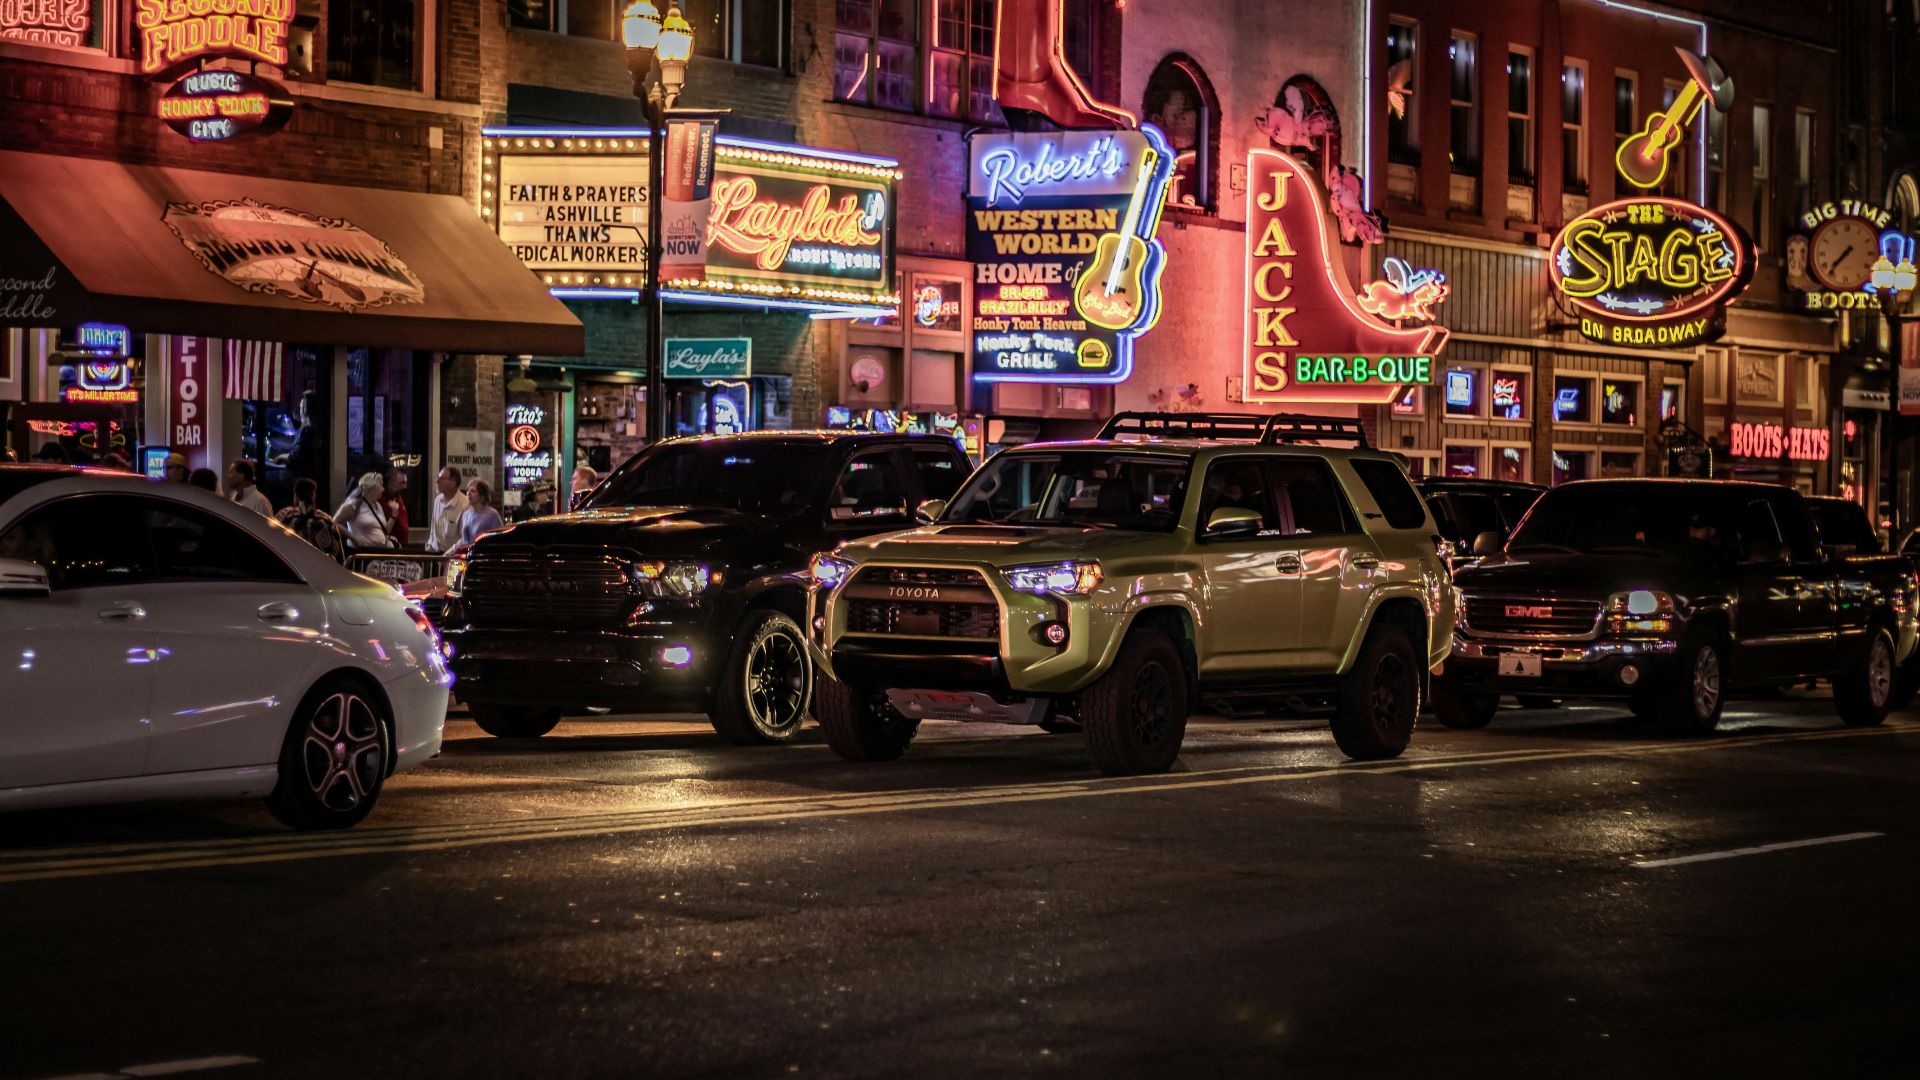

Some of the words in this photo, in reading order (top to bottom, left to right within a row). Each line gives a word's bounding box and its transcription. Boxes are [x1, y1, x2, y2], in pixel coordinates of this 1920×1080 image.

[142, 15, 287, 71] FIDDLE
[185, 73, 240, 94] MUSIC
[160, 99, 214, 118] HONKY
[216, 95, 266, 115] TONK
[191, 118, 233, 138] CITY
[682, 127, 697, 186] Rediscover.
[696, 128, 711, 187] Reconnect.
[981, 136, 1121, 206] Robert's
[509, 185, 558, 201] FAITH
[562, 186, 572, 201] &
[576, 186, 647, 202] PRAYERS
[545, 206, 622, 222] ASHVILLE
[707, 176, 881, 270] Layla's
[973, 208, 1119, 231] WESTERN
[1627, 204, 1665, 224] THE
[1802, 202, 1837, 229] BIG
[1841, 199, 1892, 229] TIME
[544, 224, 611, 243] THANKS
[993, 232, 1098, 255] WORLD
[512, 245, 568, 262] EDICAL
[571, 245, 649, 263] WORKERS
[666, 240, 701, 256] NOW
[1561, 218, 1735, 297] STAGE
[976, 263, 1062, 284] HOME
[1065, 261, 1084, 289] of
[1252, 171, 1300, 392] JACKS
[1806, 291, 1881, 309] BOOTS
[973, 316, 1010, 333] Honky
[1012, 316, 1041, 331] Tonk
[1043, 317, 1087, 331] Heaven
[1581, 318, 1605, 340] ON
[1612, 318, 1707, 344] BROADWAY
[976, 333, 1031, 353] Honky
[1032, 333, 1076, 354] Tonk
[669, 347, 746, 373] Layla's
[996, 351, 1055, 369] GRILL
[1296, 357, 1430, 383] BAR-B-QUE
[68, 391, 84, 402] IT'S
[84, 391, 114, 402] MILLER
[115, 391, 137, 402] TIME
[508, 405, 544, 425] Tito's
[176, 425, 201, 445] BAR
[1729, 422, 1783, 459] BOOTS
[1787, 427, 1831, 462] HATS
[465, 442, 477, 452] THE
[447, 455, 470, 465] ROBERT
[473, 456, 493, 466] MOORE
[506, 452, 550, 468] Handmade
[514, 467, 543, 477] VODKA
[888, 586, 940, 599] TOYOTA
[1503, 605, 1553, 619] GMC
